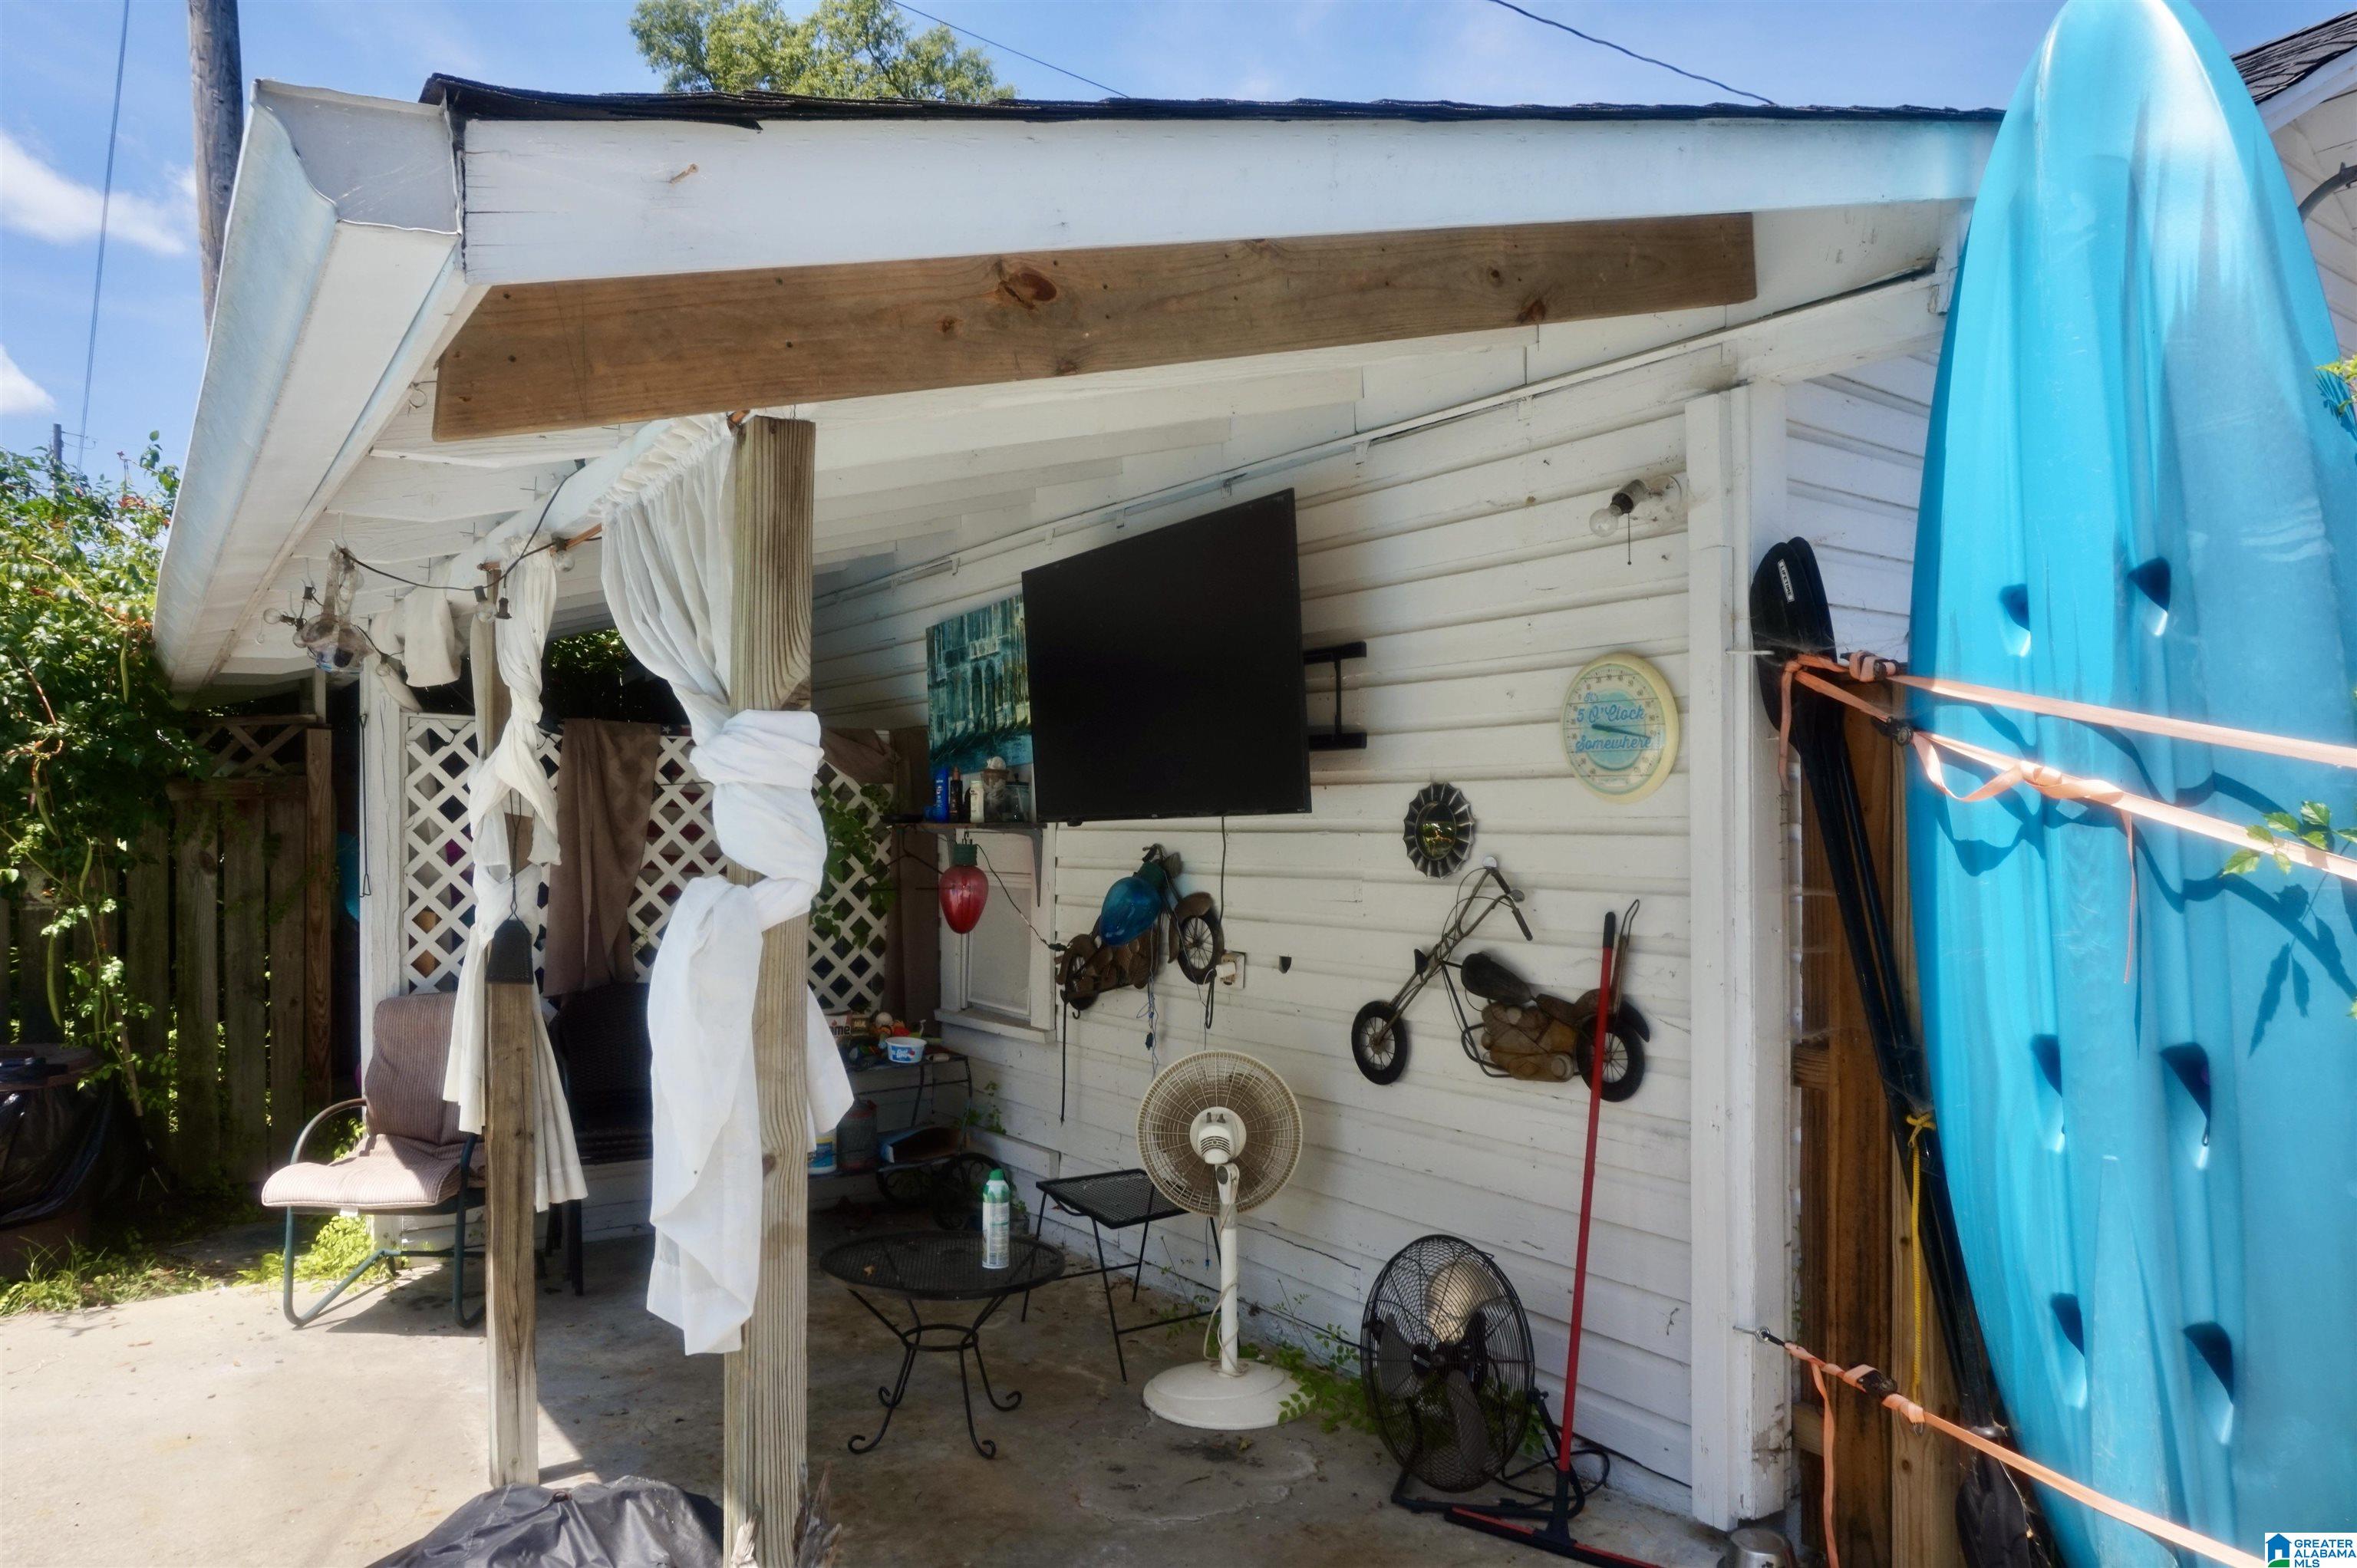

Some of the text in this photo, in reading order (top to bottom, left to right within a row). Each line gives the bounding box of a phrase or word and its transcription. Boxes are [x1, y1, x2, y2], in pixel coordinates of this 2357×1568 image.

[1780, 565, 1792, 596] LIFETIME
[1577, 709, 1586, 723] 5
[1575, 735, 1652, 753] Somewhere
